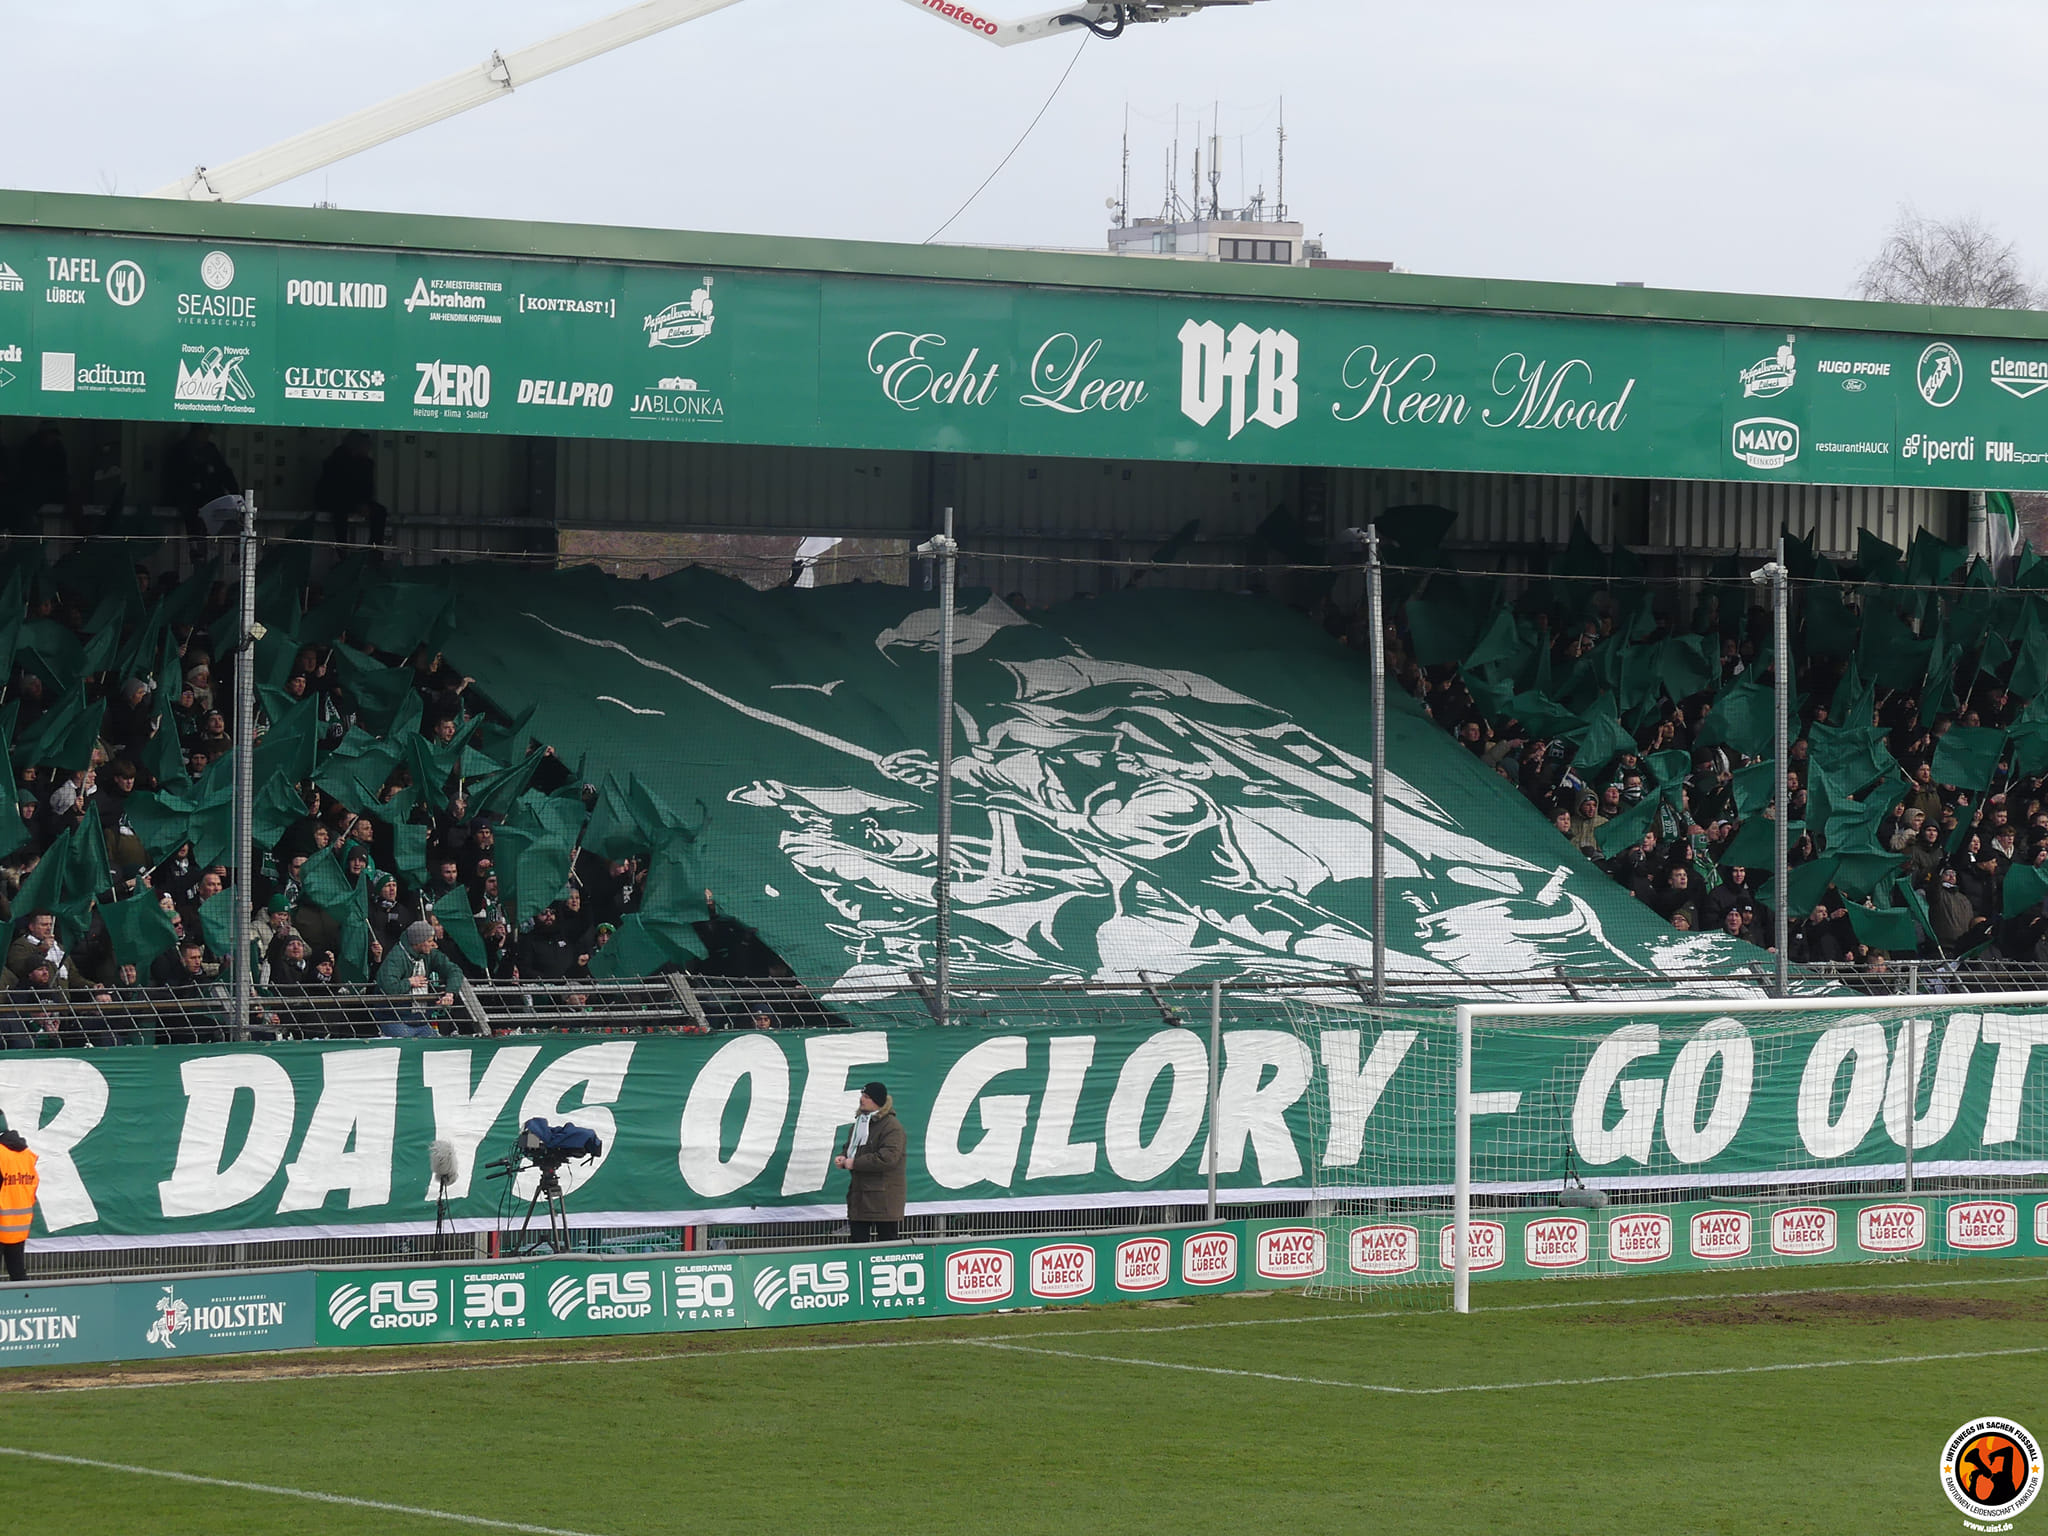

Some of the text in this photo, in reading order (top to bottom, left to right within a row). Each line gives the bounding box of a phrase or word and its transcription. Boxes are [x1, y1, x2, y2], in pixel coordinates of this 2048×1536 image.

[47, 256, 101, 283] TAFEL
[430, 279, 503, 292] KFZ-MEISTERBETRIEB
[46, 286, 86, 304] LÜBECK
[403, 277, 486, 313] Abraham
[177, 293, 256, 318] SEASIDE
[429, 312, 502, 324] JAN-HENDRIK HOFFMANN
[77, 363, 146, 386] aditum
[867, 330, 1148, 414] Echt Leev
[1817, 360, 1891, 375] HUGO PFOHE
[285, 366, 371, 388] GLÜCKS
[301, 389, 369, 400] EVENTS
[517, 379, 614, 408] DELLPRO
[1331, 344, 1636, 432] Keen Mood
[413, 407, 439, 419] Heizung
[443, 409, 461, 418] Klima
[630, 394, 724, 415] JABLONKA
[1739, 429, 1793, 451] MAYO
[1815, 441, 1889, 454] restaurantHAUCK
[1922, 433, 1974, 466] iperdi
[1749, 455, 1781, 466] FEINKOST
[0, 1058, 109, 1233] R
[158, 1041, 637, 1219] DAYS
[678, 1031, 890, 1198] OF
[925, 1029, 1420, 1188] GLORY
[1571, 1017, 1755, 1165] GO
[1798, 1012, 2048, 1159] OUT
[1700, 1217, 1740, 1233] MAYO
[1783, 1214, 1826, 1230] MAYO
[1869, 1211, 1915, 1227] MAYO
[1959, 1208, 2006, 1224] MAYO
[1535, 1225, 1578, 1241] MAYO
[1619, 1221, 1661, 1237] MAYO
[1192, 1239, 1228, 1258] MAYO
[1268, 1235, 1314, 1253] MAYO
[1361, 1232, 1407, 1249] MAYO
[870, 1253, 924, 1263] CELEBRATING
[1041, 1252, 1084, 1270] MAYO
[1125, 1245, 1161, 1264] MAYO
[674, 1264, 732, 1274] CELEBRATING
[957, 1257, 1003, 1275] MAYO
[463, 1272, 525, 1282] CELEBRATING
[789, 1261, 849, 1295] FLS
[870, 1263, 925, 1298] 30
[369, 1280, 438, 1313] FLS
[586, 1271, 652, 1305] FLS
[674, 1274, 734, 1308] 30
[463, 1283, 525, 1318] 30
[790, 1293, 850, 1310] GROUP
[872, 1297, 926, 1308] YEARS
[193, 1301, 283, 1330] HOLSTEN
[369, 1312, 438, 1329] GROUP
[587, 1303, 652, 1320] GROUP
[676, 1308, 735, 1320] YEARS
[0, 1315, 77, 1343] OLSTEN
[464, 1318, 526, 1329] YEARS
